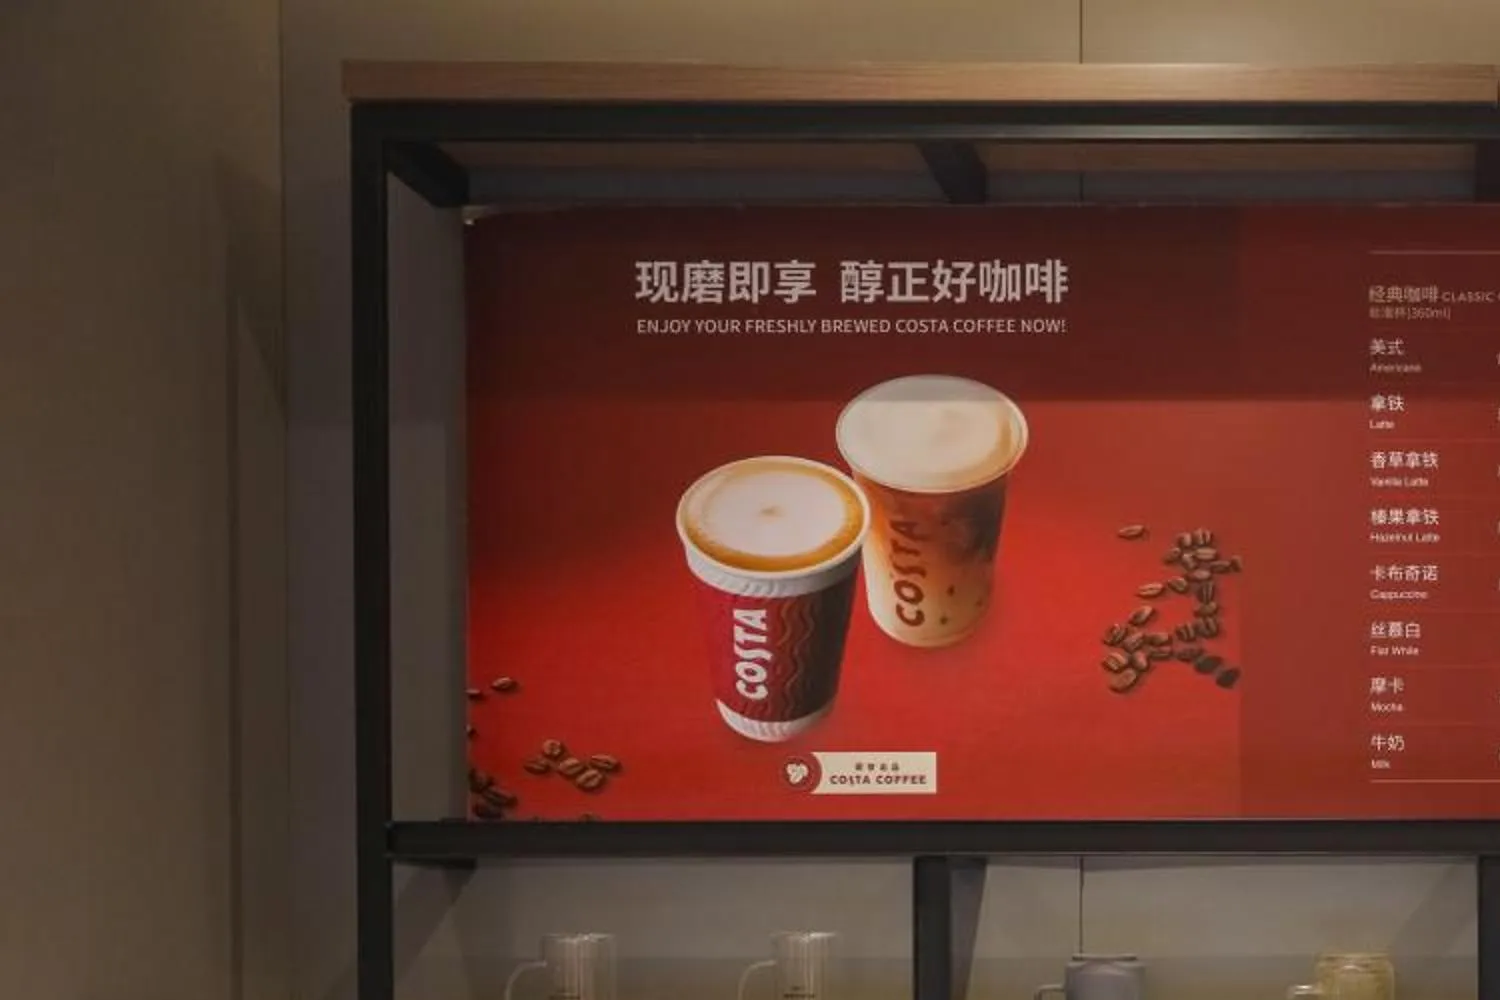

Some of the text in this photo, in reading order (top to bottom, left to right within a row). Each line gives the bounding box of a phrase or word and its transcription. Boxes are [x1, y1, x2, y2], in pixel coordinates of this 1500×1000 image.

[635, 259, 1069, 304] 现磨即享 醇正好咖啡
[1369, 285, 1439, 303] 经典咖啡
[636, 318, 1067, 334] ENJOY YOUR FRESHLY BREWED COSTA COFFEE NOW!
[889, 519, 931, 627] COSTA
[733, 608, 773, 701] COSTA
[830, 775, 927, 785] COSTA COFFEE
